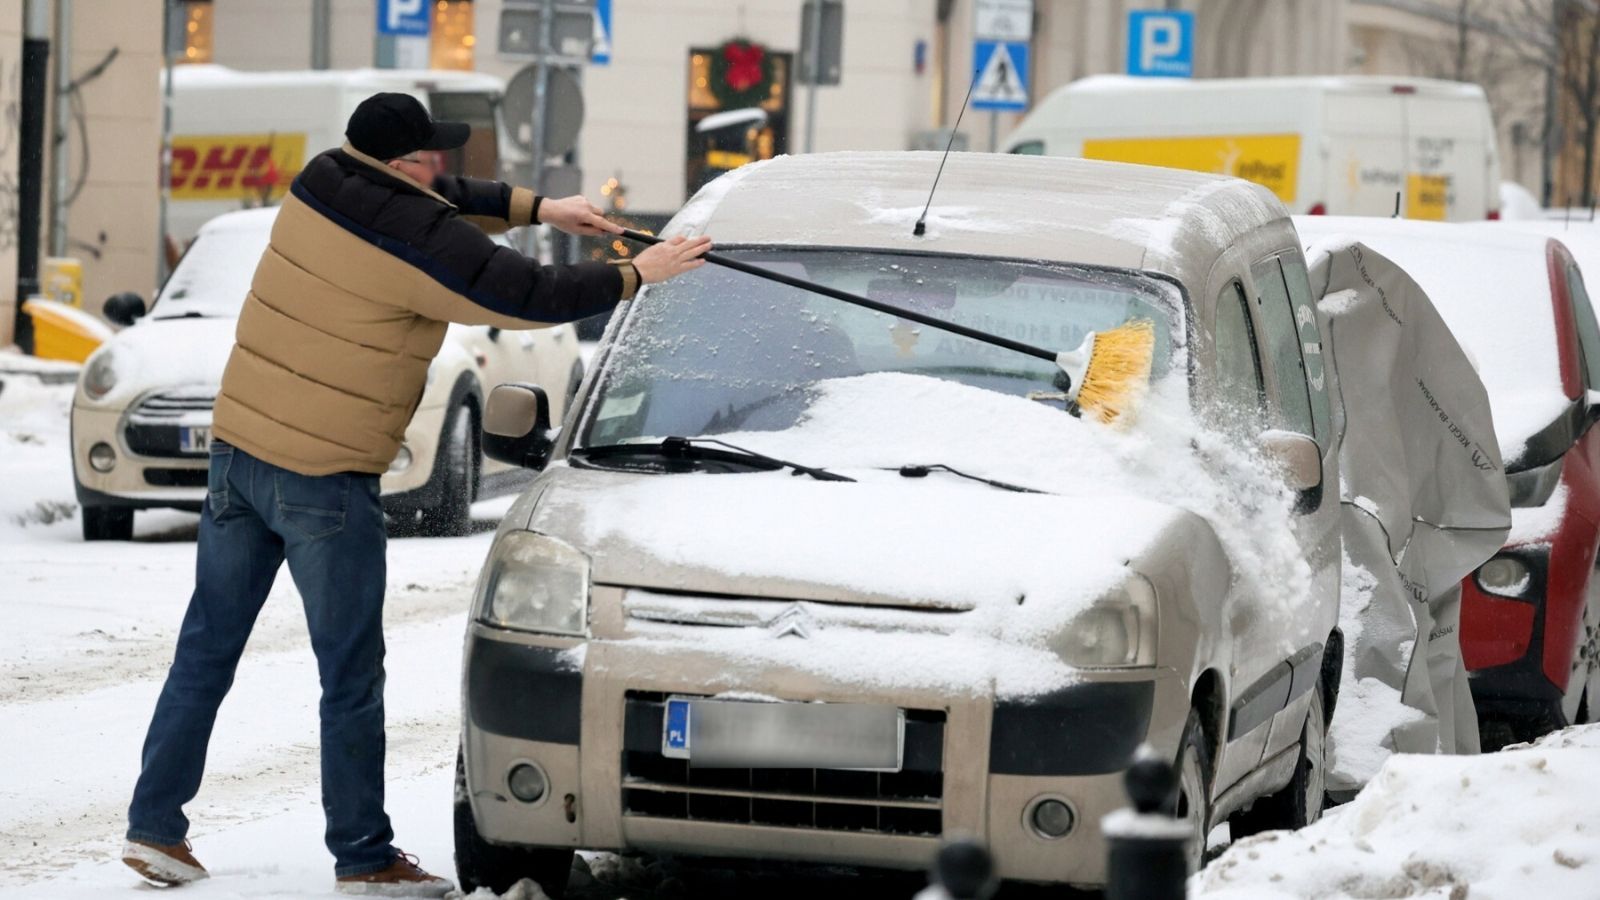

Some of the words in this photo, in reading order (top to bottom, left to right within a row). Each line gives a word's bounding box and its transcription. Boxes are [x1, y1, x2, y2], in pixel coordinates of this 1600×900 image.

[1141, 16, 1181, 71] P
[162, 146, 275, 188] DHL
[194, 431, 207, 447] W
[670, 730, 684, 742] PL
